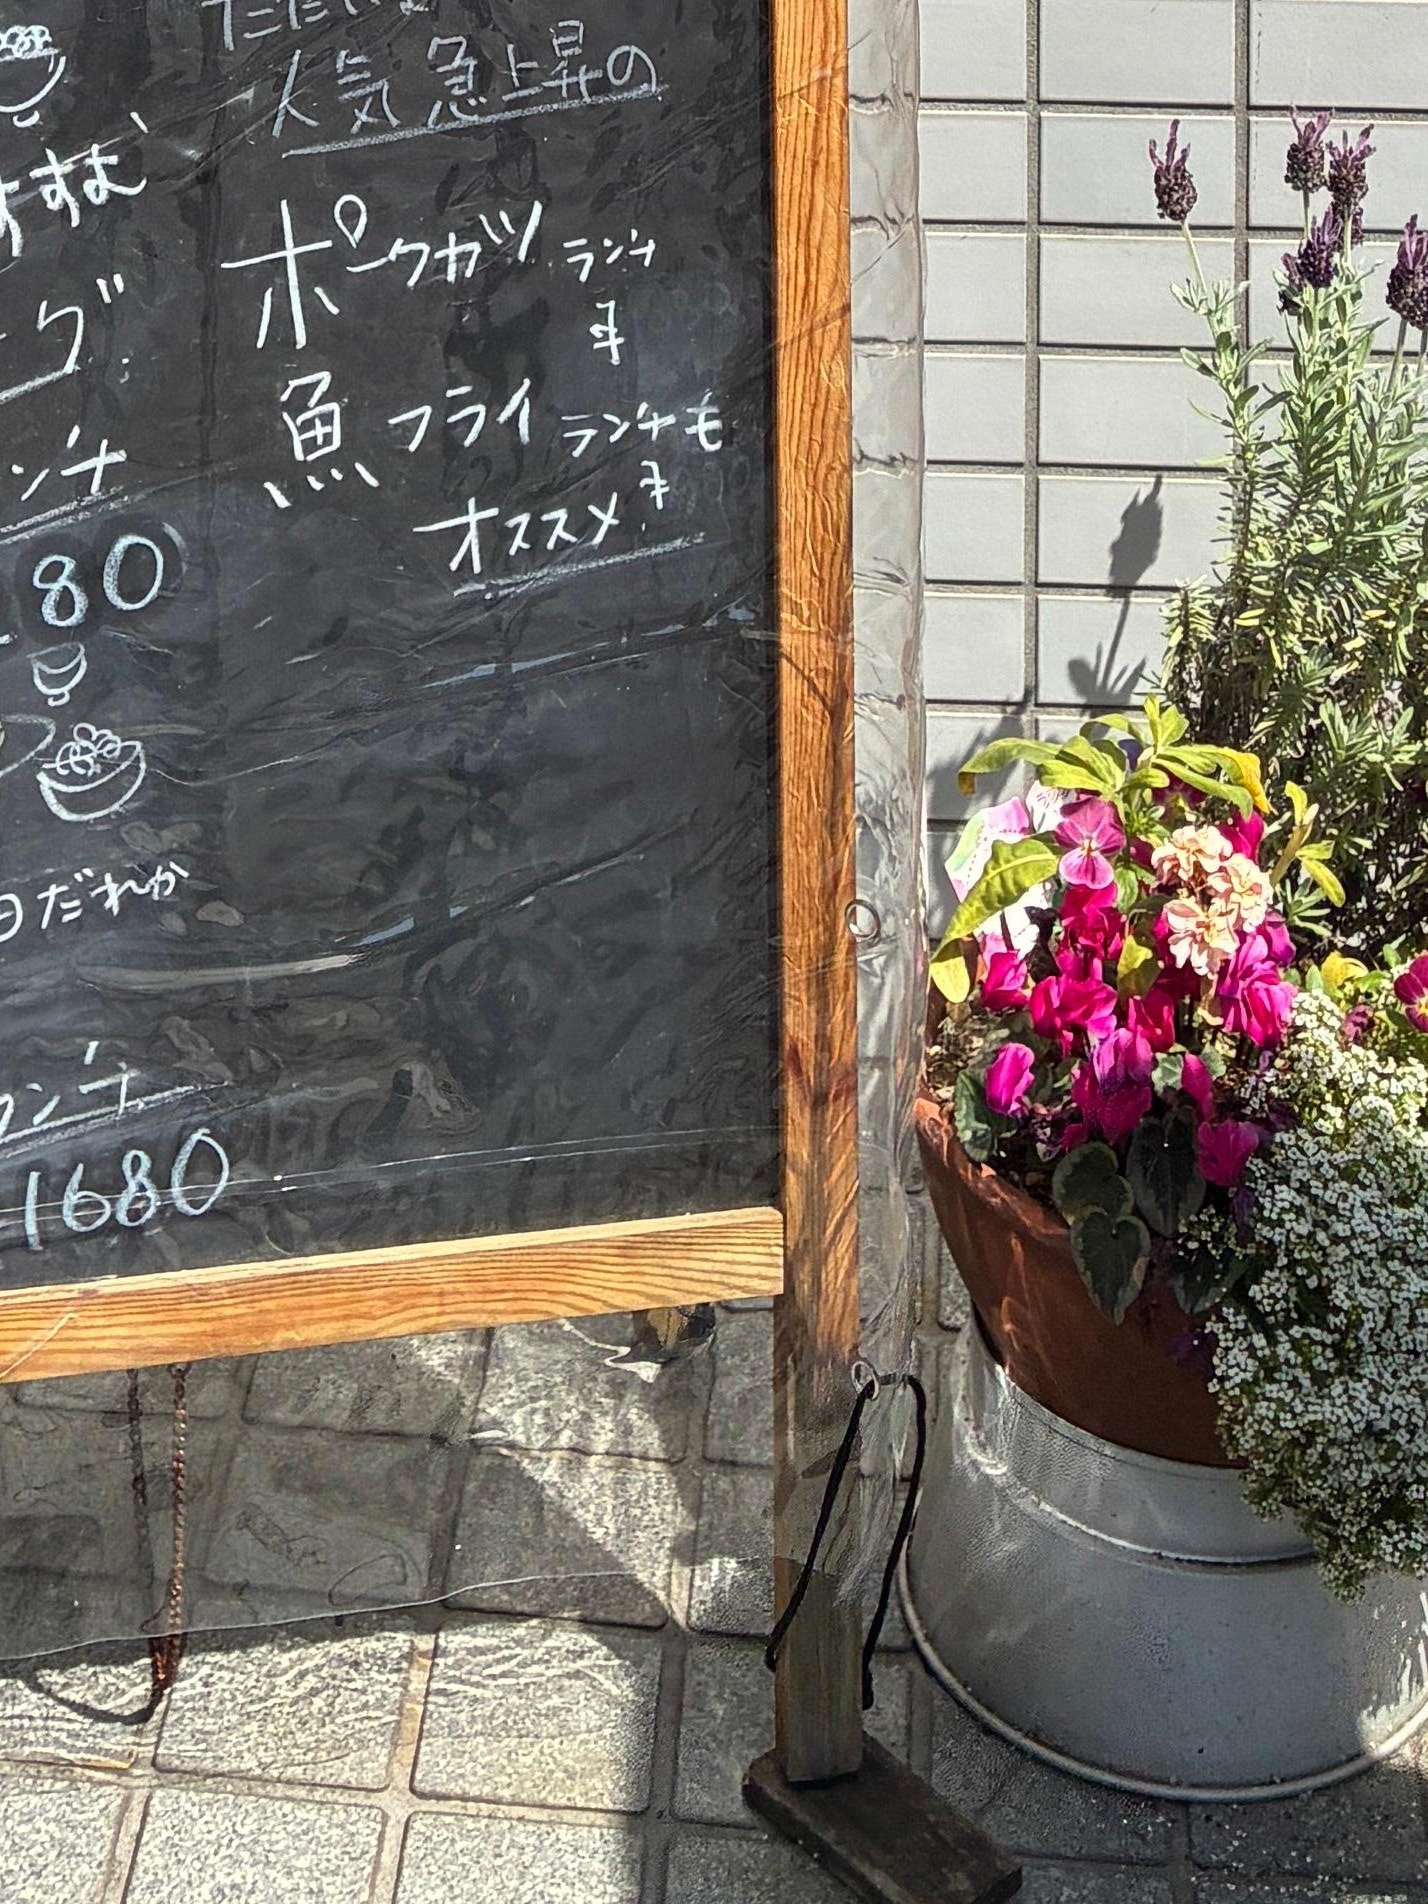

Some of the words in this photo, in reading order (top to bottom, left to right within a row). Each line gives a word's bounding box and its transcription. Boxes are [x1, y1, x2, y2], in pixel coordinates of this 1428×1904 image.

[272, 20, 659, 137] 人気急上昇の
[563, 229, 655, 282] ランチ
